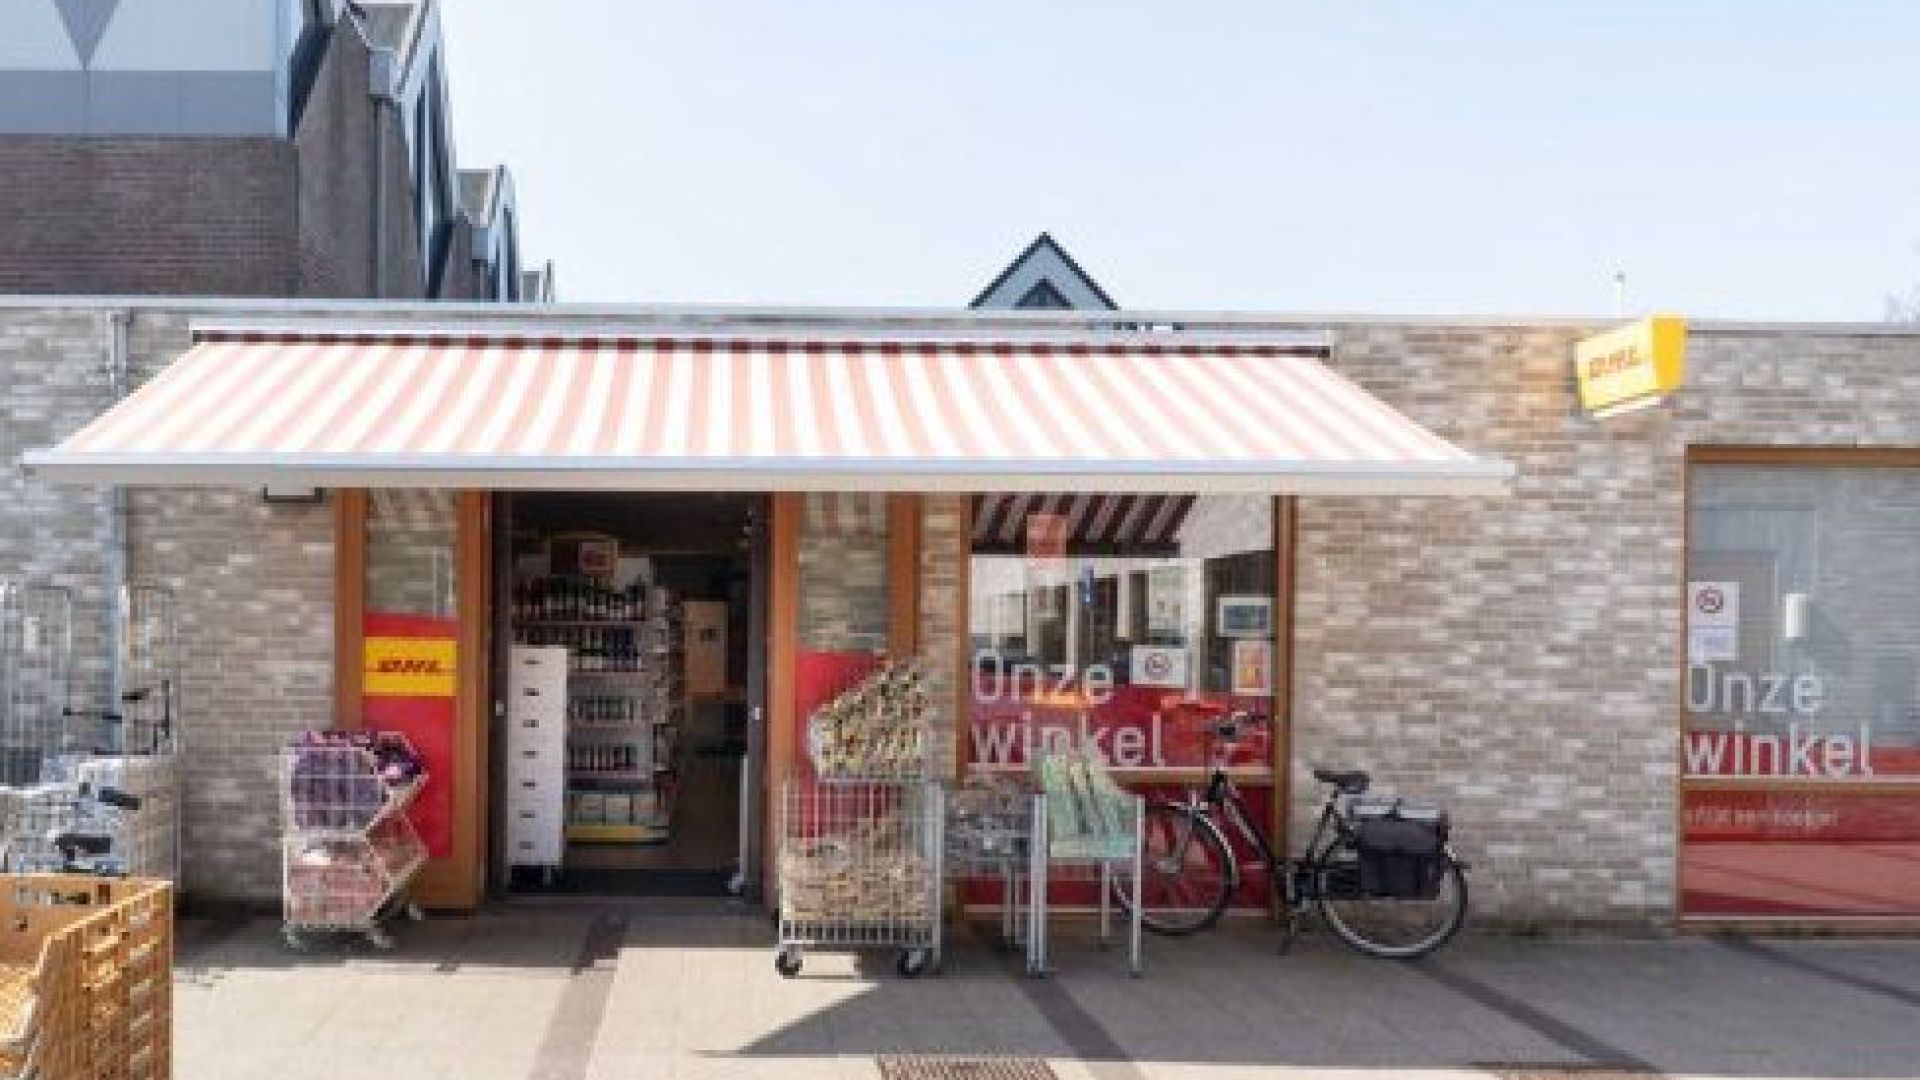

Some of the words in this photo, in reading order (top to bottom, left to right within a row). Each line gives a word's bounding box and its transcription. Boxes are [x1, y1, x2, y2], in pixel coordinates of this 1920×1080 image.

[1588, 345, 1642, 380] DHL
[378, 658, 442, 674] DHL
[973, 649, 1114, 702] Onze
[1687, 664, 1823, 713] Onze
[971, 711, 1165, 767] winkel
[1684, 720, 1874, 777] winkel
